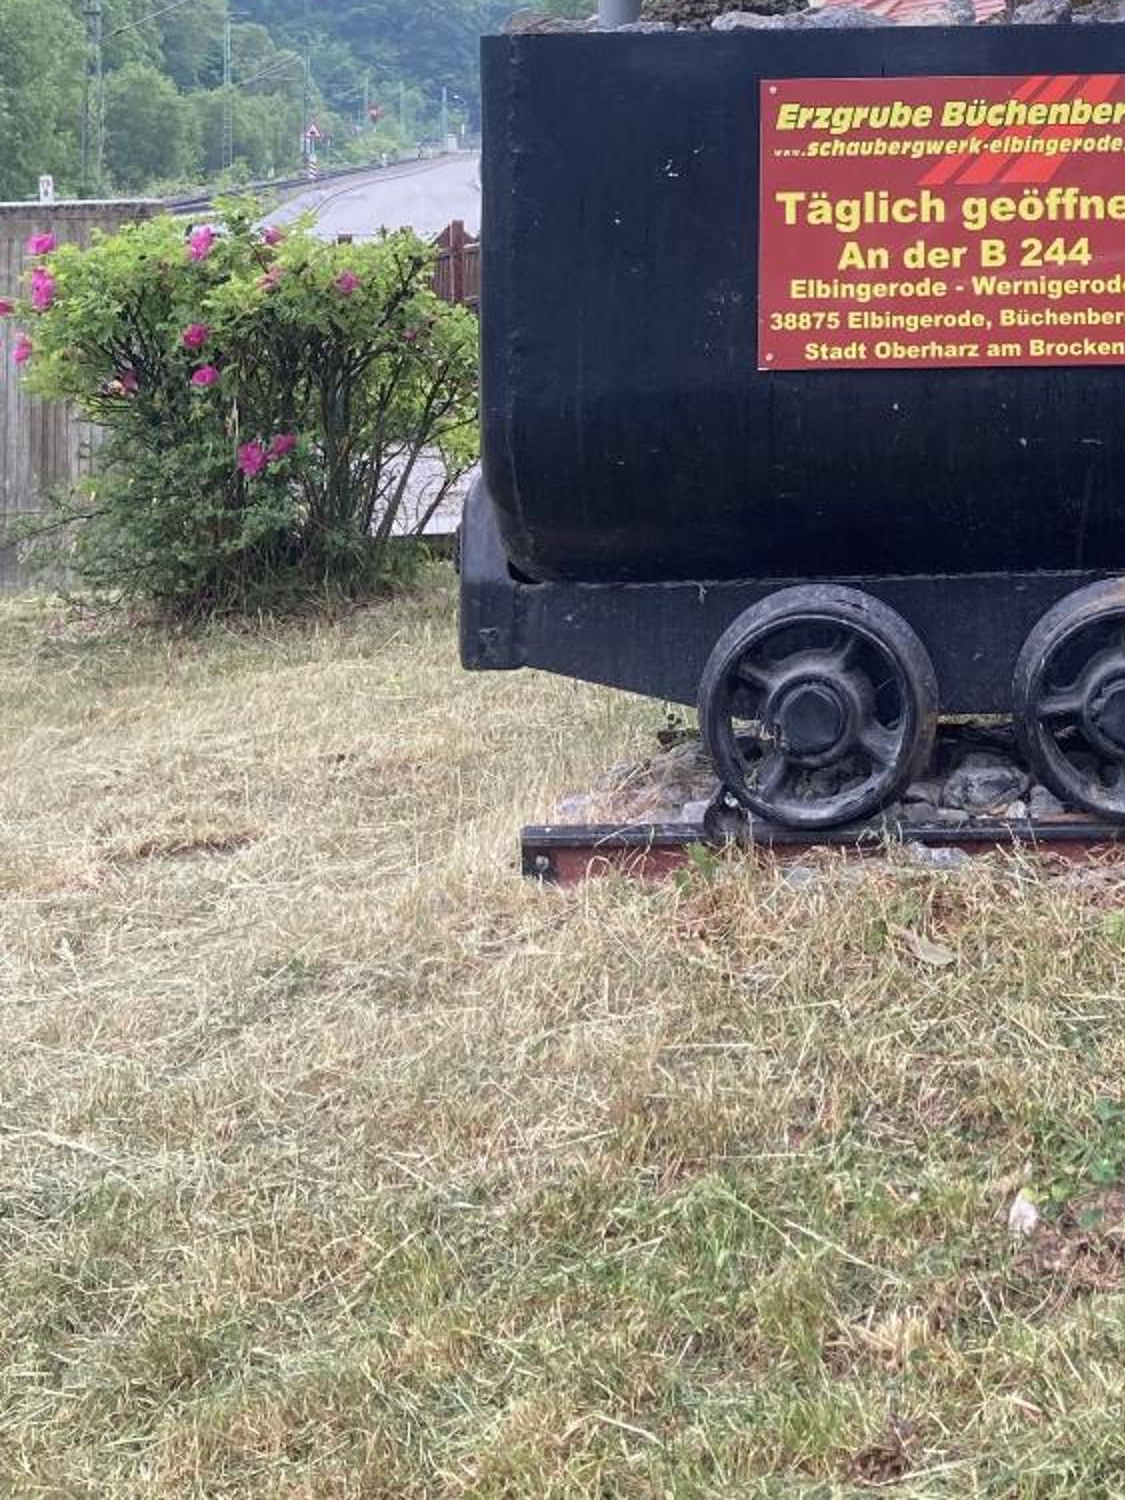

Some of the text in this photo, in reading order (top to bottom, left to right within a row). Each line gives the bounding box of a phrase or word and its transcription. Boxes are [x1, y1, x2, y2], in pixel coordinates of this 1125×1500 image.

[776, 102, 933, 135] Erzgrube
[776, 190, 945, 232] Täglich
[837, 237, 1092, 271] An der B 244
[790, 279, 947, 303] Elbingerode
[770, 312, 840, 331] 38875
[848, 310, 992, 333] Elbingerode,
[805, 339, 1125, 361] Stadt Oberharz am Brocken
